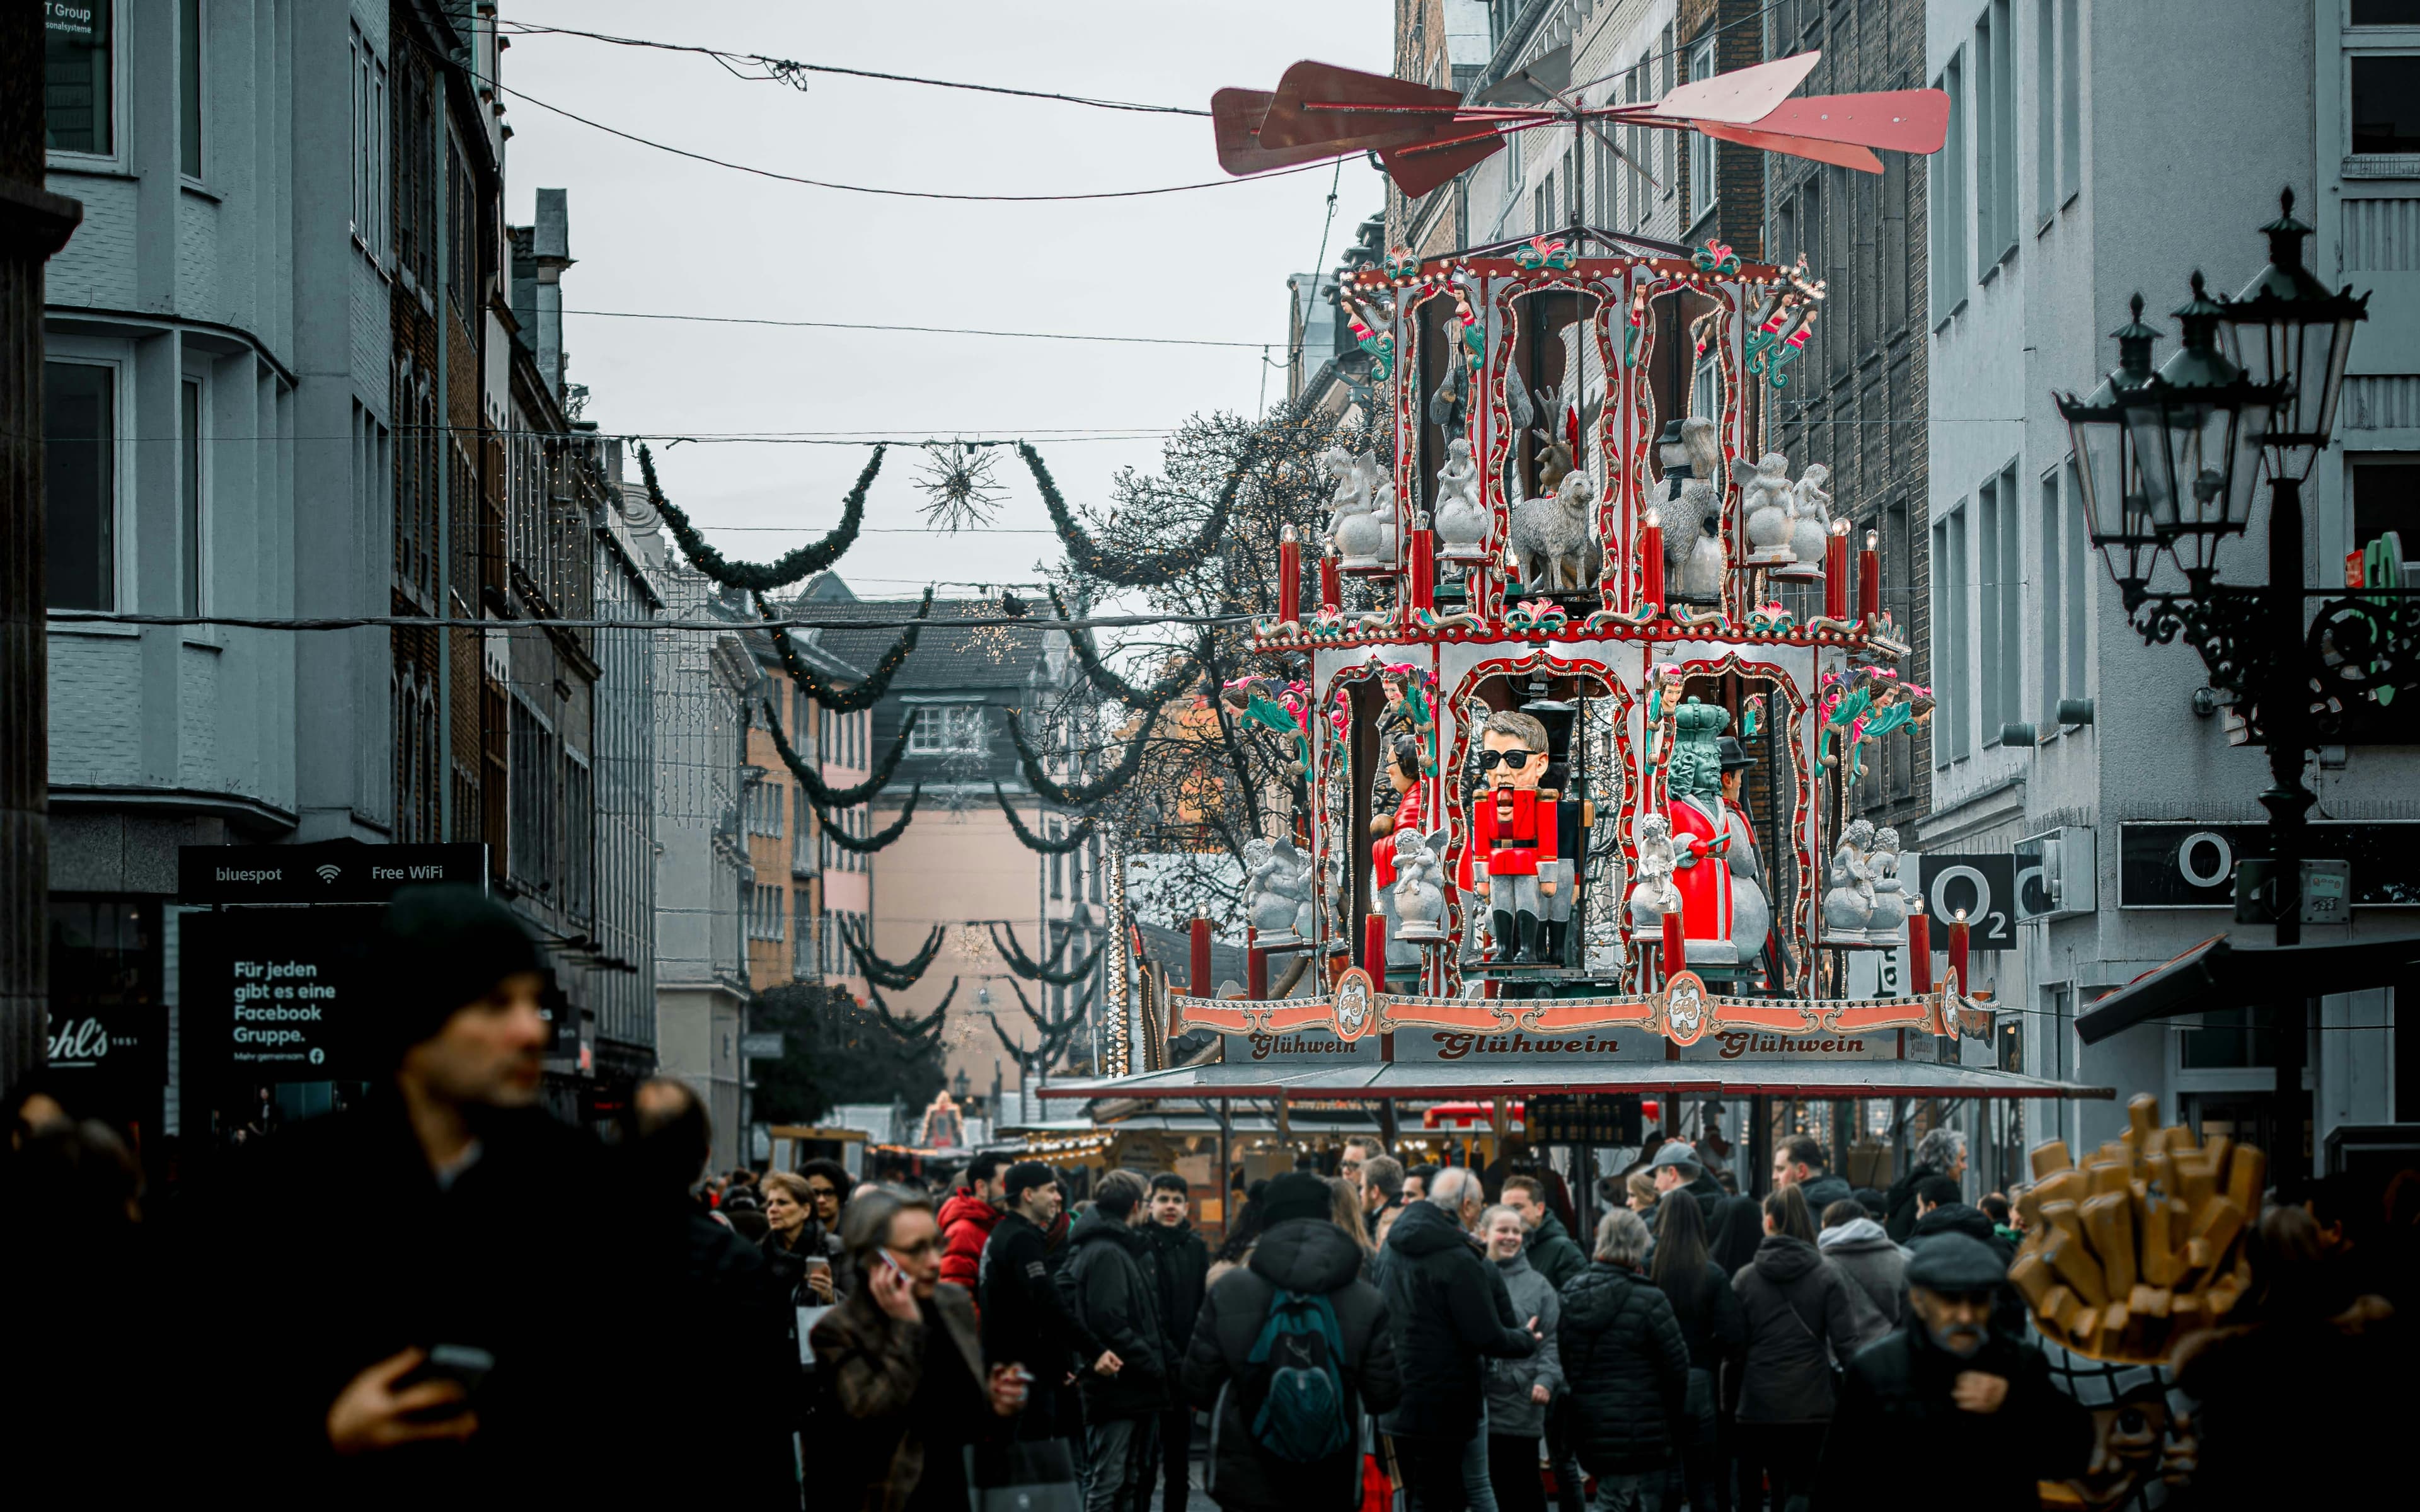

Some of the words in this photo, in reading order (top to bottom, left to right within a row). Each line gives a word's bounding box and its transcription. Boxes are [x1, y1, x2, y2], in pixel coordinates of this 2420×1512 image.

[55, 3, 91, 23] Group
[216, 868, 282, 884] bluespot
[372, 866, 404, 879] Free
[409, 866, 443, 879] WiFi
[234, 961, 263, 977] Für
[265, 961, 317, 981] jeden
[234, 983, 270, 1003] gibt
[274, 987, 294, 999] es
[297, 983, 336, 999] eine
[234, 1004, 322, 1020] Facebook
[233, 1027, 306, 1046] Gruppe.
[1248, 1032, 1357, 1060] Glühwein
[1432, 1032, 1620, 1060] Glühwein
[1714, 1031, 1865, 1059] Glühwein
